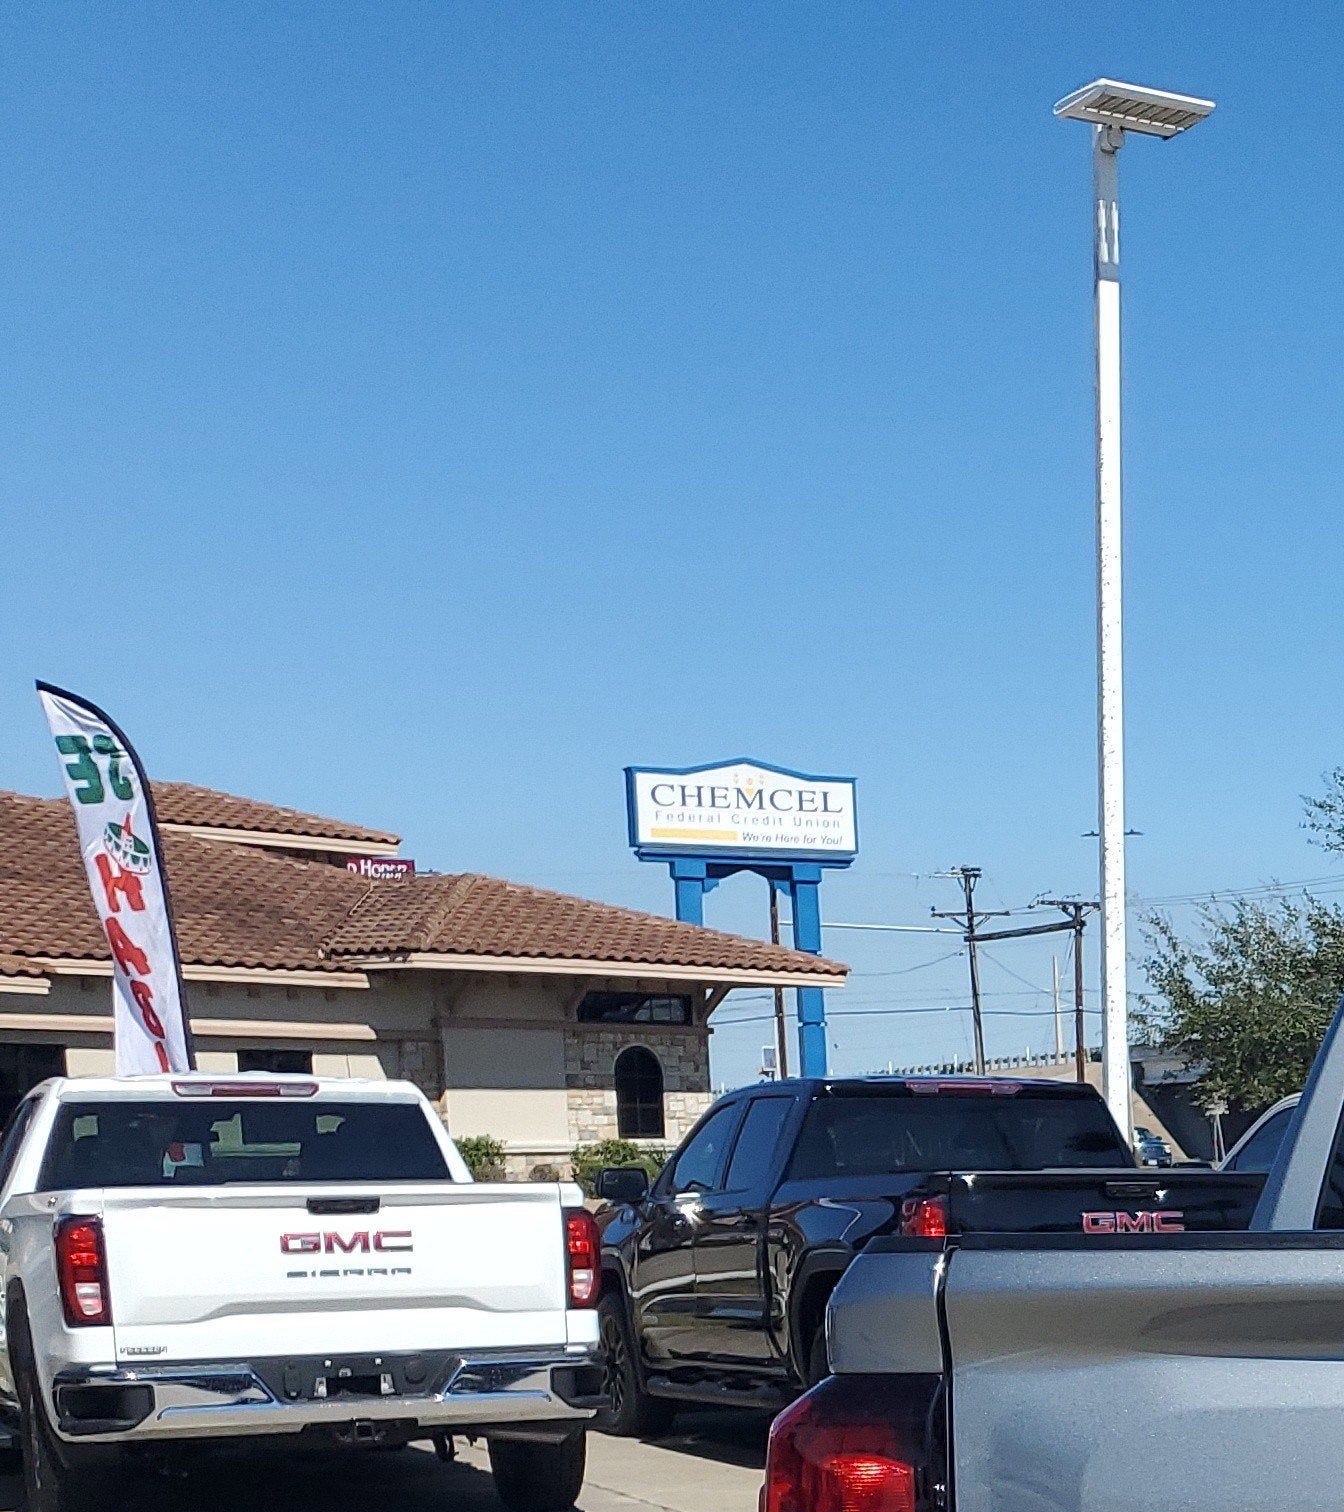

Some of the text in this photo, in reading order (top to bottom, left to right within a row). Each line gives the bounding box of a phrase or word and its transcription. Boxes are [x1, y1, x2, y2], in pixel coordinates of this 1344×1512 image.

[650, 783, 844, 814] CHEMCEL
[655, 810, 841, 829] Federal Credit Union
[742, 832, 843, 846] We're Here for You!
[1082, 1210, 1184, 1234] GMC
[280, 1230, 413, 1255] GMC
